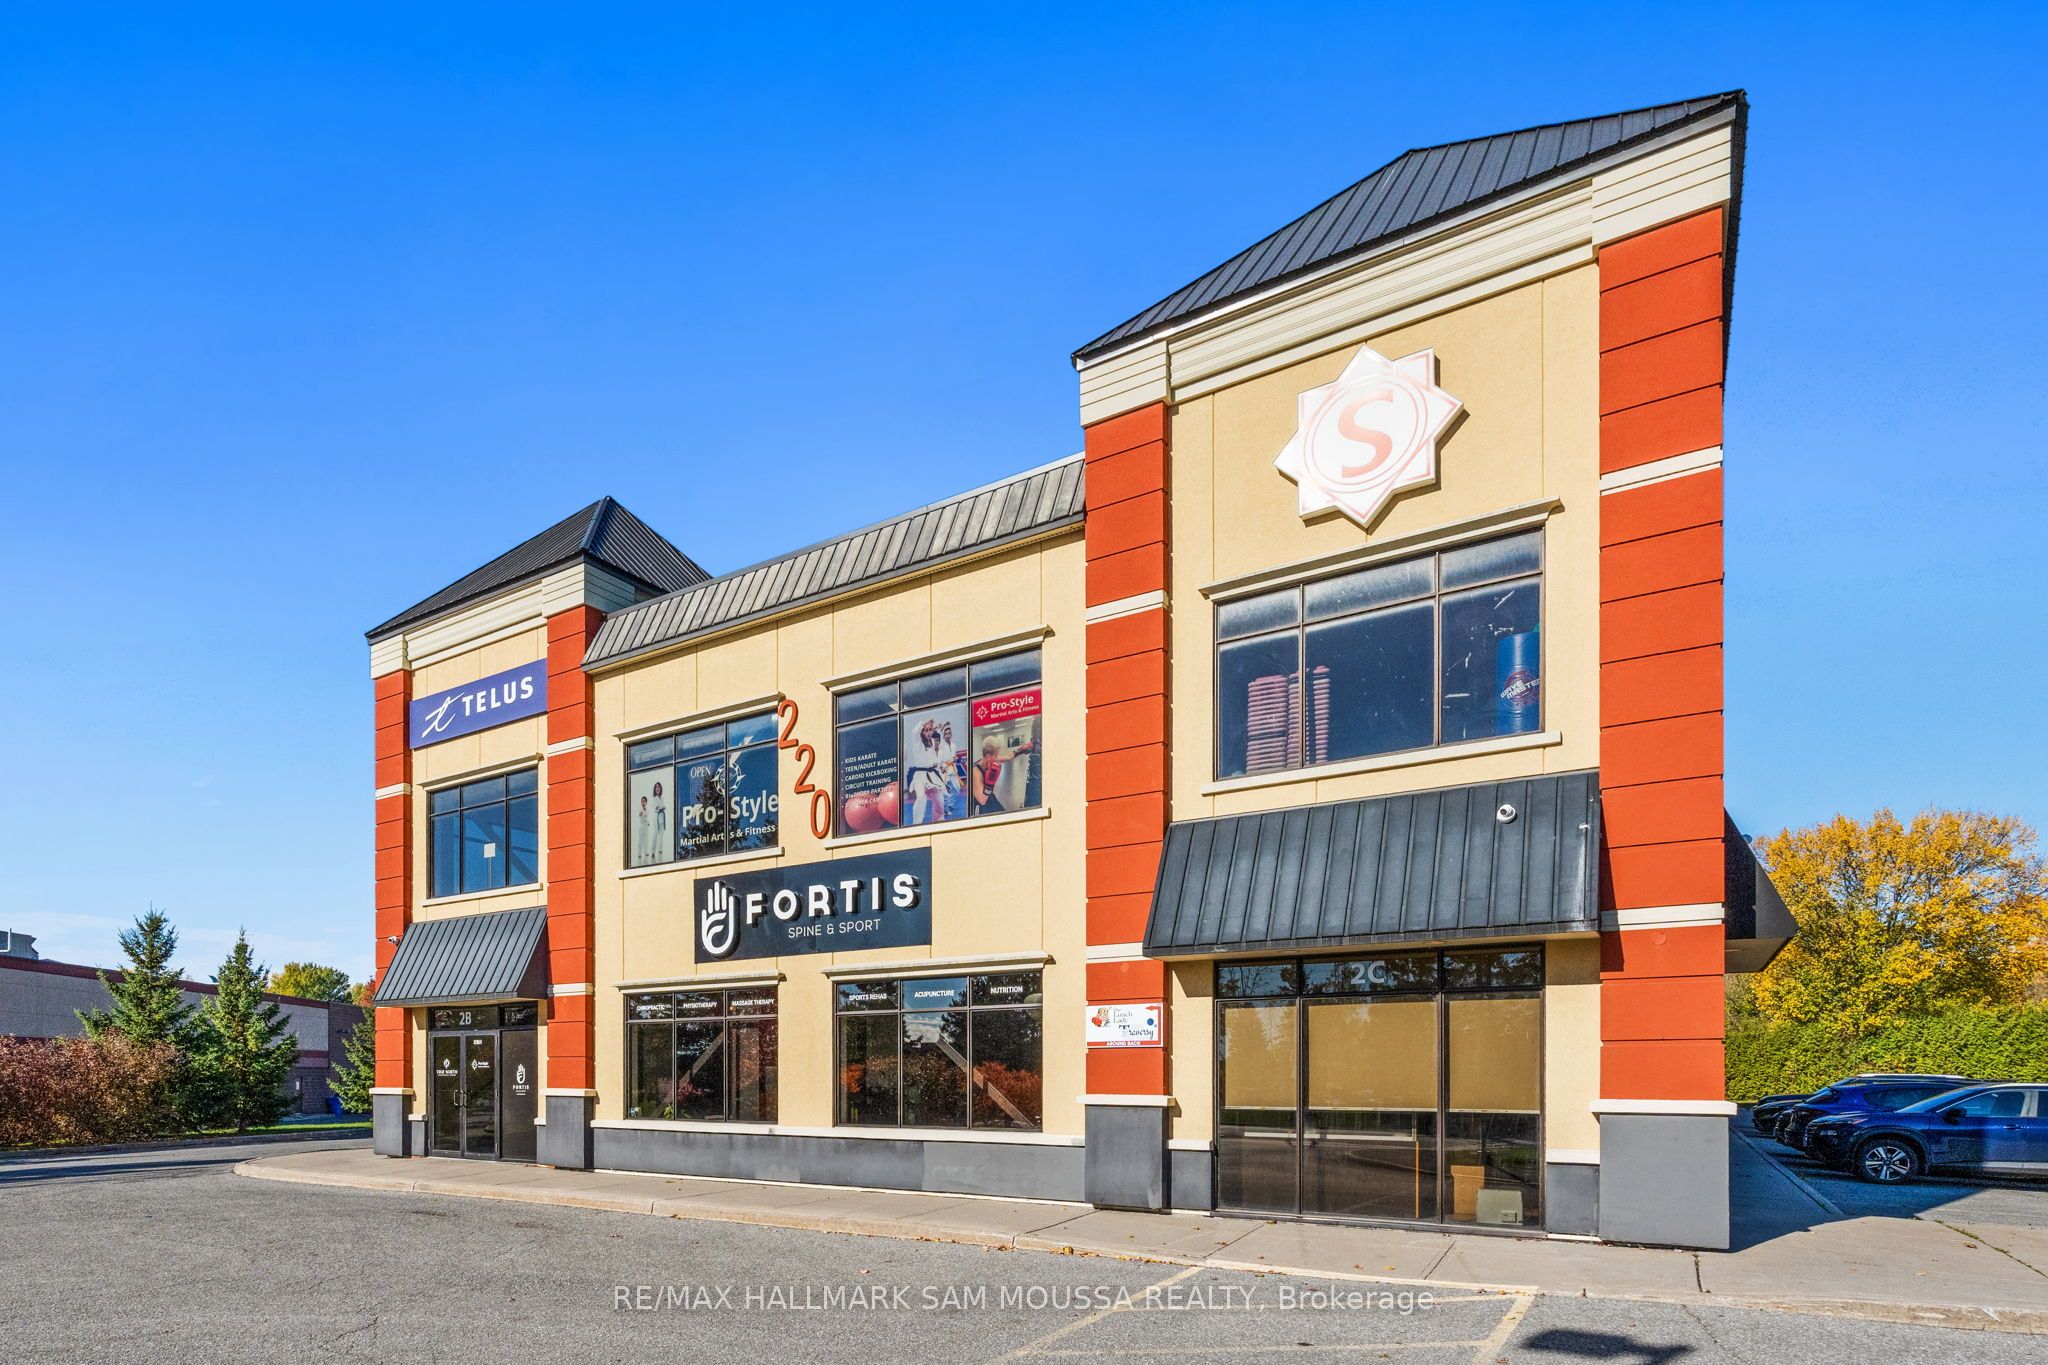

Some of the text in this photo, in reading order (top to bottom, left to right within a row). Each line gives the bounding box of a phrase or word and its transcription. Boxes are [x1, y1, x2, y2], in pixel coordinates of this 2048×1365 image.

[1338, 389, 1394, 479] S
[462, 676, 533, 716] TELUS
[1500, 680, 1524, 699] WAVE
[991, 694, 1034, 711] Pro-Style
[990, 711, 1007, 719] Martial
[845, 752, 877, 764] KIDS KARATE
[845, 757, 897, 773] TEEN/ADULT KARATE
[690, 765, 712, 779] OPEN
[845, 766, 898, 782] CARDIO KICKBOXING
[845, 776, 891, 790] CIRCUIT TRAINING
[680, 834, 710, 847] Martial
[736, 829, 743, 838] &
[745, 824, 776, 836] Fitness
[746, 873, 917, 925] FORTIS
[788, 918, 881, 938] SPINE & SPORT
[1350, 960, 1386, 985] 2C
[848, 992, 887, 1001] SPORTS REHAB
[914, 989, 955, 998] ACUPUNCTURE
[990, 985, 1023, 994] NUTRITION
[683, 1001, 718, 1009] PHYSIOTHERAPY
[731, 999, 754, 1007] MASSAGE
[459, 1011, 472, 1026] 2B
